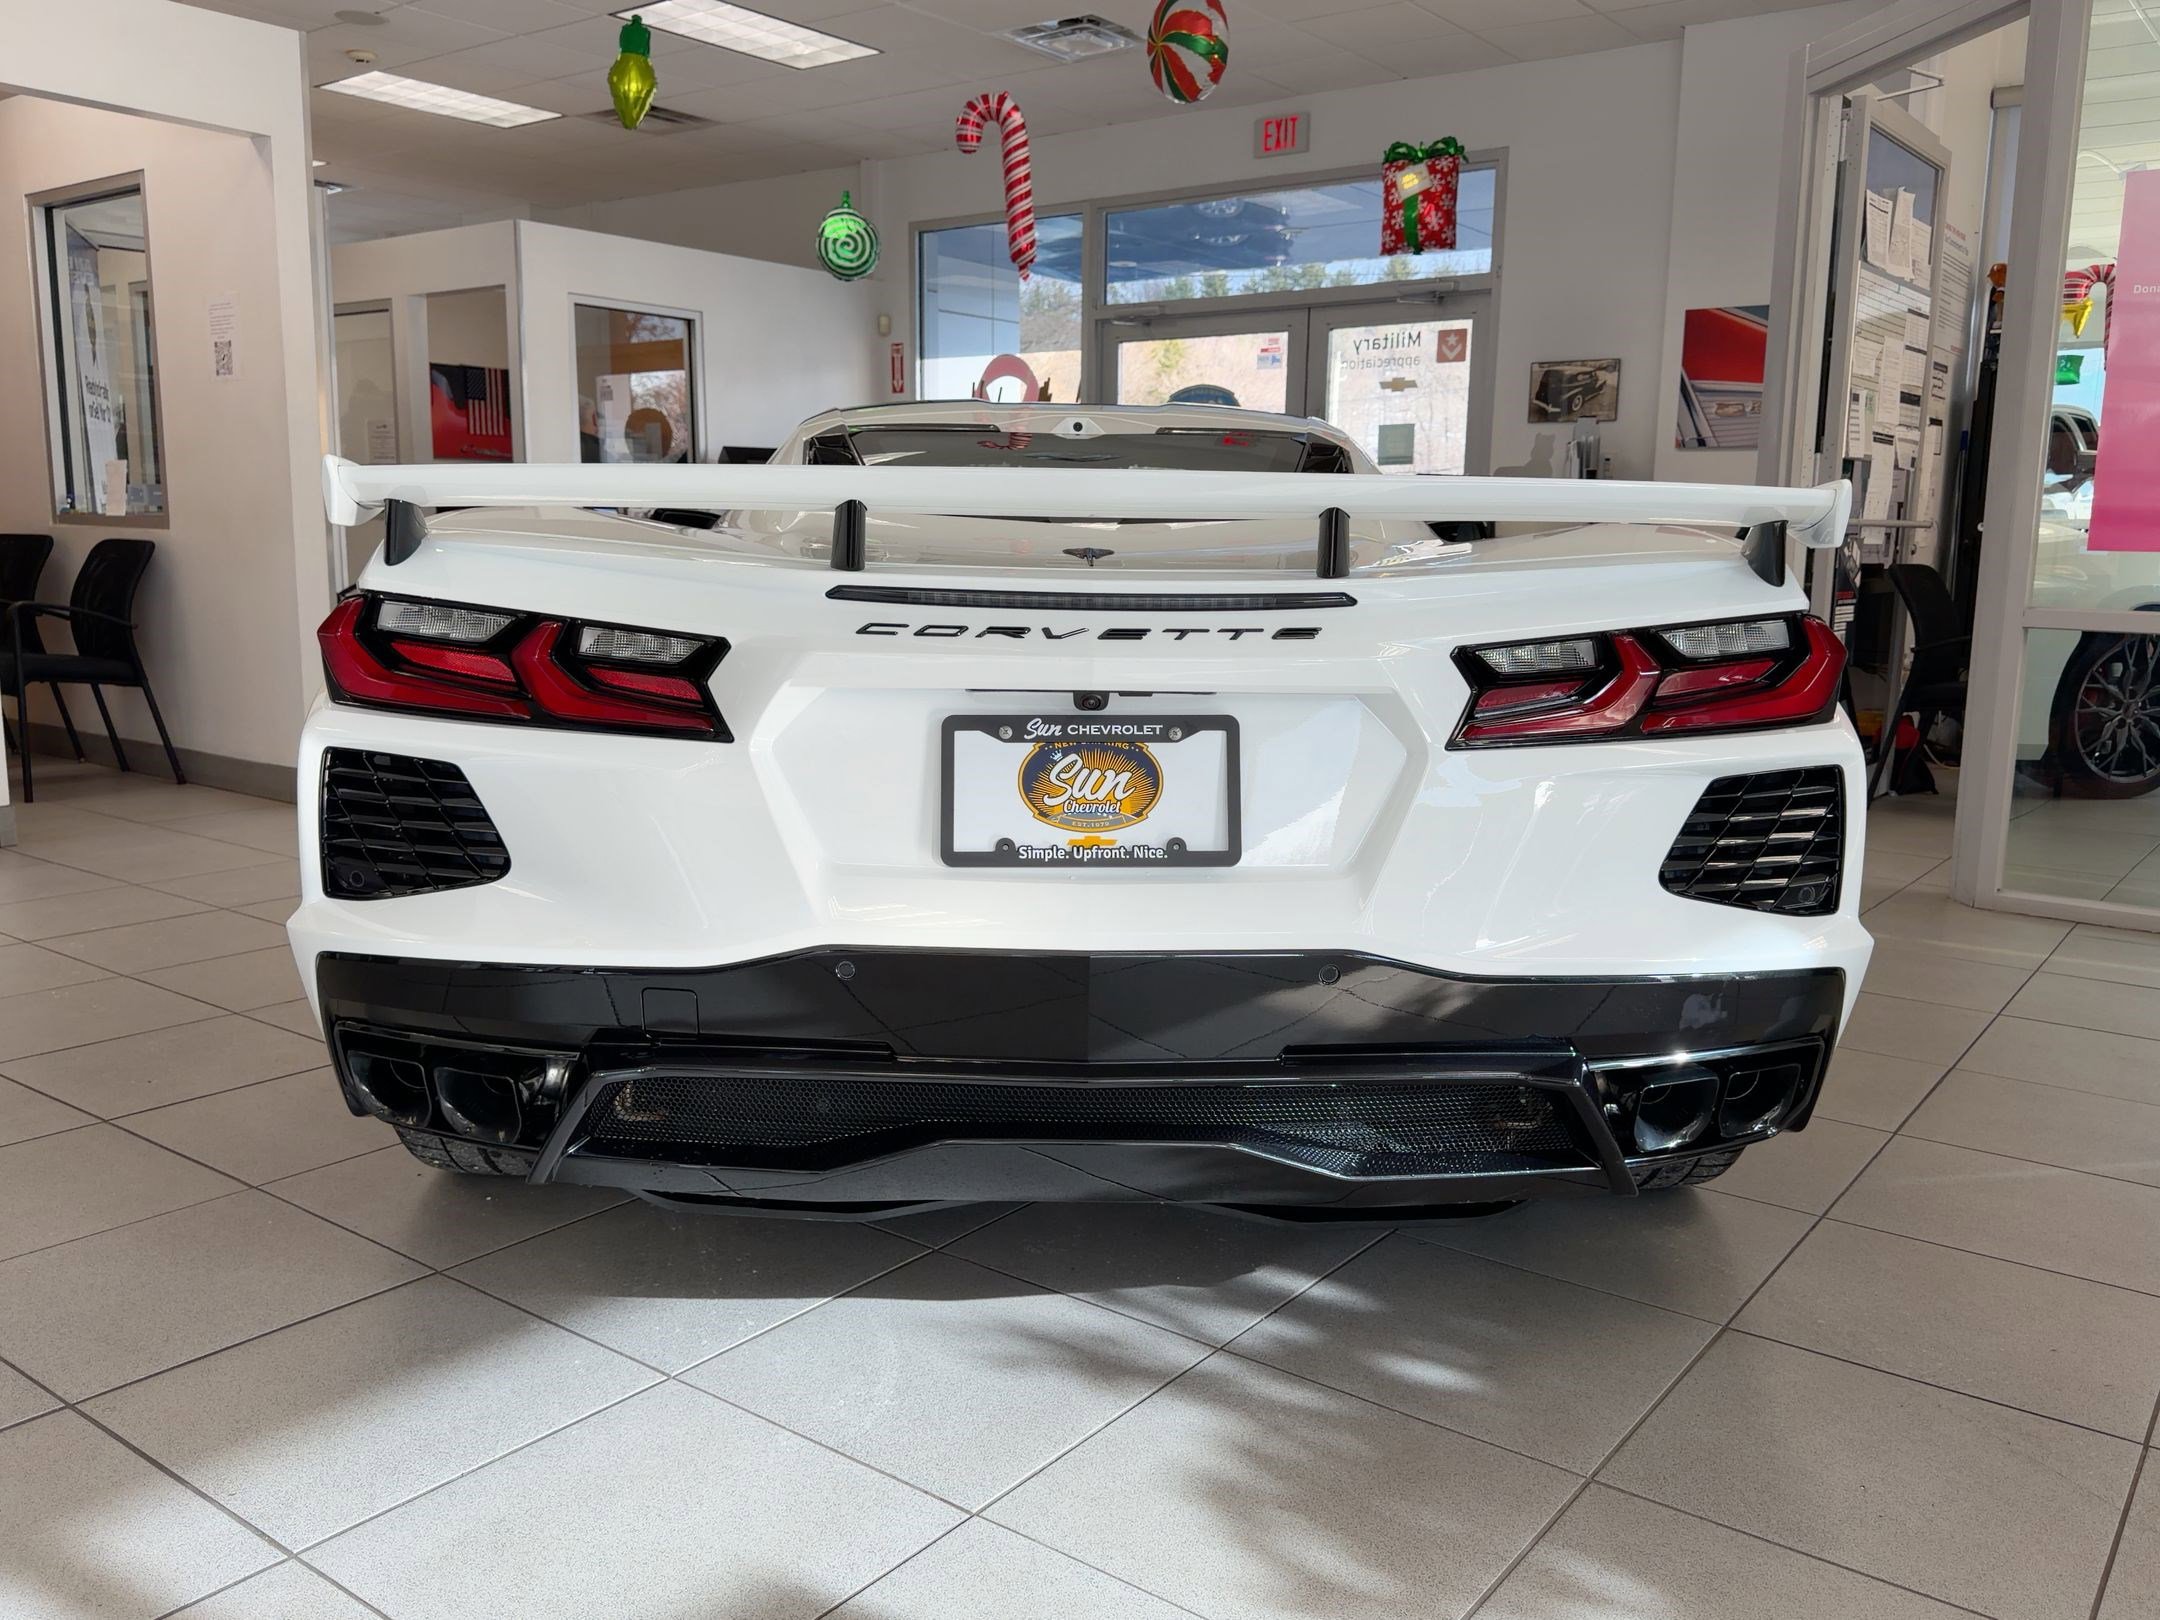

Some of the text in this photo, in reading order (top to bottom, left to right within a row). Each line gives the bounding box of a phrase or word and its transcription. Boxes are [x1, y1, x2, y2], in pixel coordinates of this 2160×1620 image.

[1263, 116, 1298, 152] EXIT
[855, 622, 1323, 641] CORVETTE
[1024, 718, 1163, 740] Sun CHEVROLET
[1043, 753, 1137, 806] Sun
[1063, 799, 1121, 814] Chevrolet
[1018, 846, 1168, 861] Simple. Upfront. Nice.
